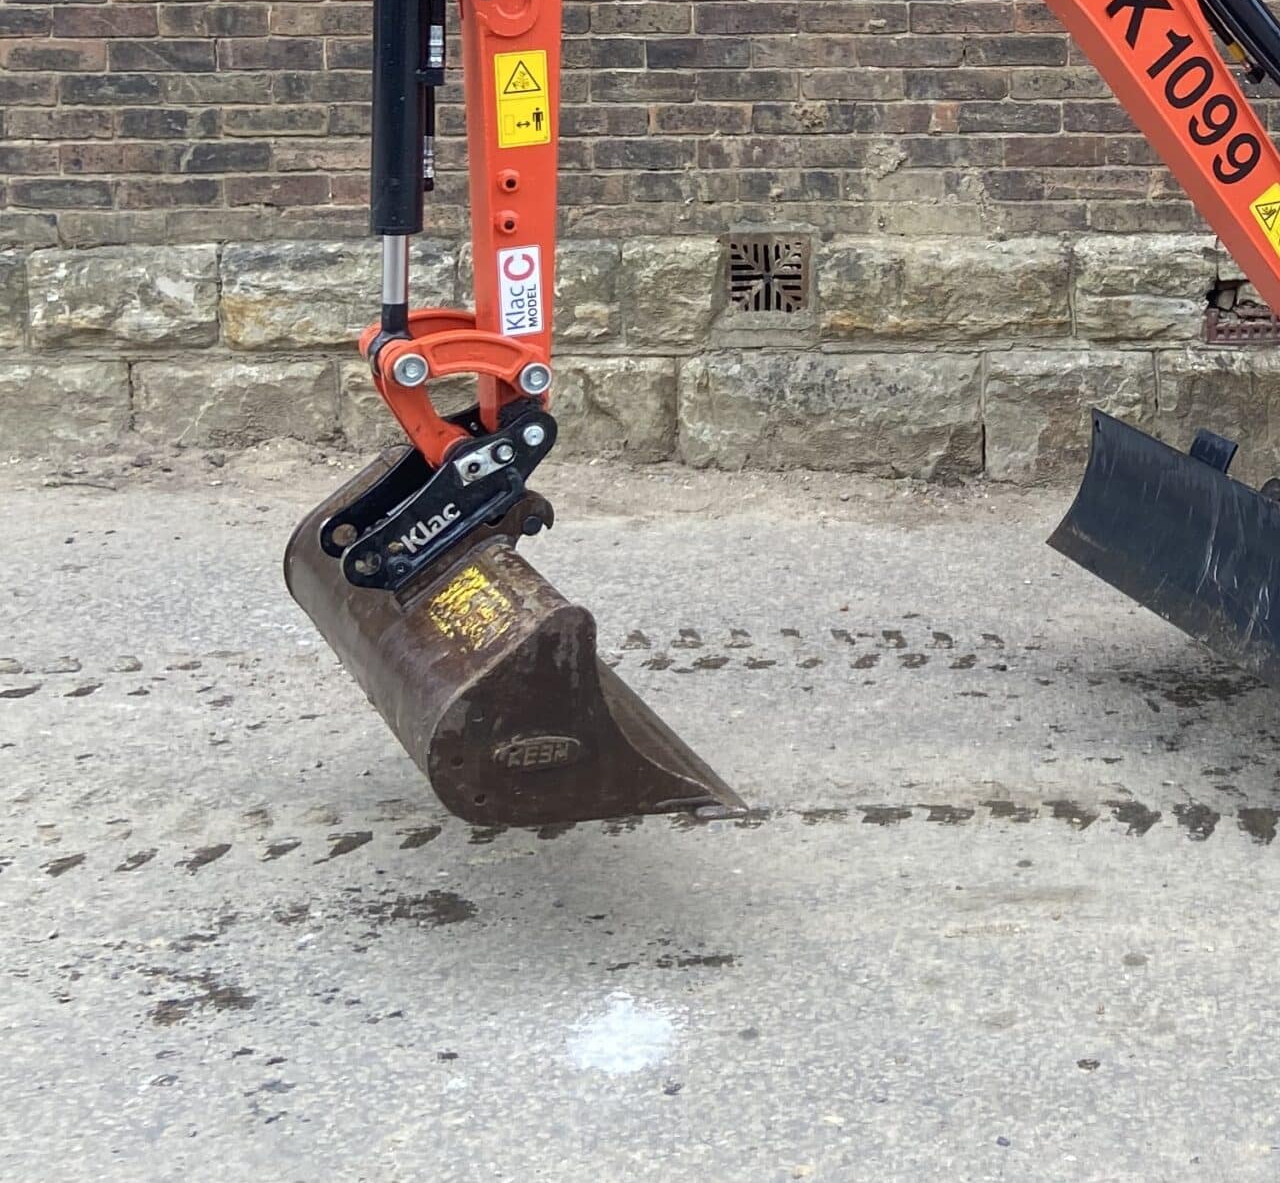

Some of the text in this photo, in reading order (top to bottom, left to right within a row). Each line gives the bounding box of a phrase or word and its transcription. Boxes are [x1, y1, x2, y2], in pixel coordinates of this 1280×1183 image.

[503, 253, 535, 330] Klac C
[527, 283, 538, 327] MODEL
[400, 502, 462, 554] Klac
